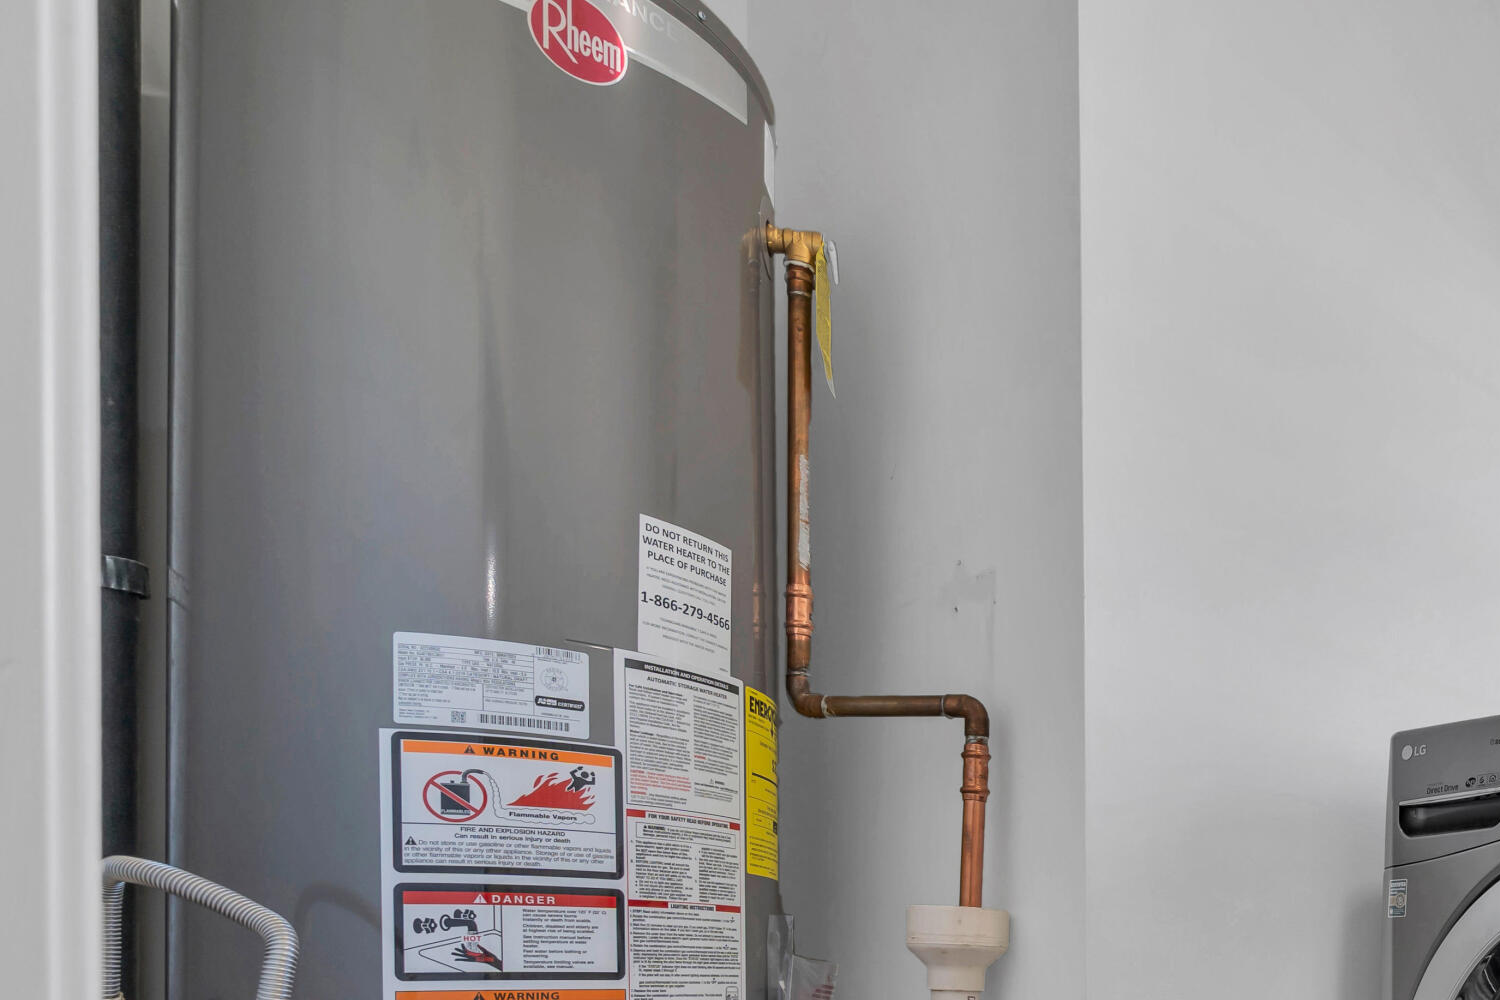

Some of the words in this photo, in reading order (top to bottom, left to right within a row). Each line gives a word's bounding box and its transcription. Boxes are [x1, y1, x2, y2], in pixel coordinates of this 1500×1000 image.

[543, 0, 622, 73] Rheem
[645, 523, 660, 535] DO
[662, 528, 681, 542] NOT
[683, 535, 714, 555] RETURN
[714, 549, 729, 562] THIS
[642, 535, 674, 553] WATER
[676, 546, 706, 565] HEATER
[707, 558, 717, 569] TO
[718, 562, 730, 576] THE
[647, 551, 675, 566] PLACE
[677, 560, 688, 570] OF
[690, 566, 727, 587] PURCHASE
[641, 591, 730, 631] 1-866-279-4566
[482, 746, 560, 761] WARNING
[1413, 744, 1427, 756] LG
[1426, 785, 1443, 795] Direct
[1444, 783, 1459, 793] Drive
[508, 811, 551, 820] Flammable
[552, 813, 578, 822] Vapors
[495, 827, 536, 835] EXPLOSION
[491, 894, 557, 905] DANGER
[493, 991, 560, 1000] WARNING
